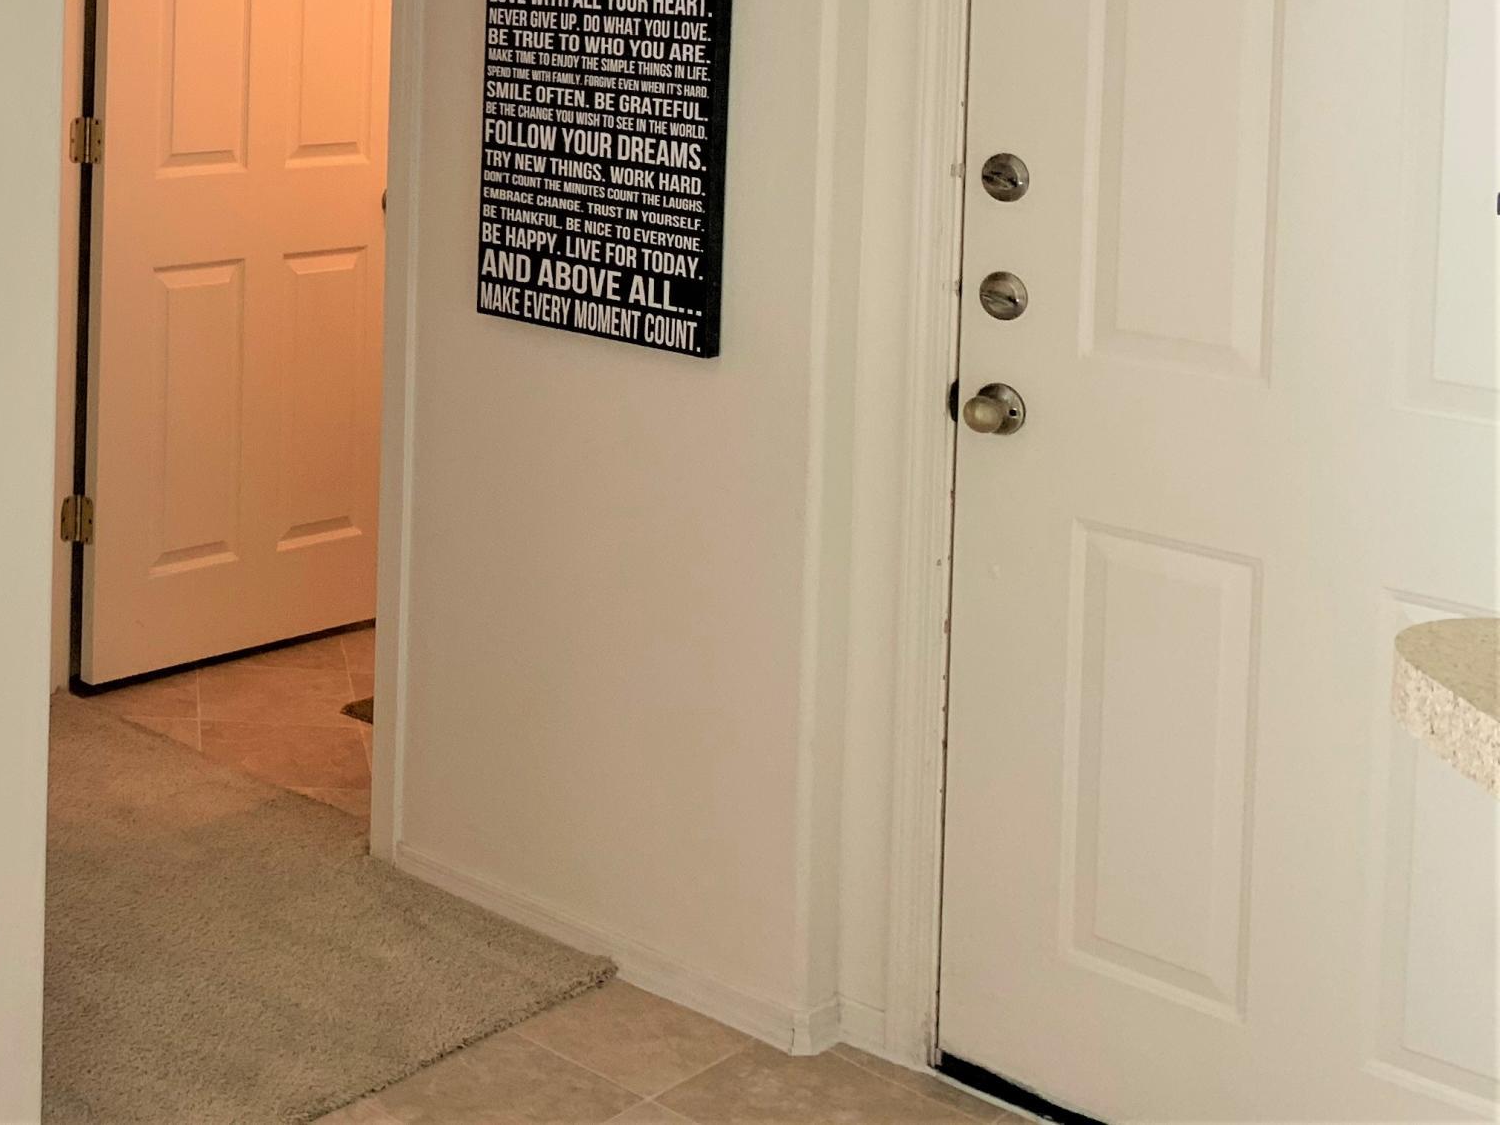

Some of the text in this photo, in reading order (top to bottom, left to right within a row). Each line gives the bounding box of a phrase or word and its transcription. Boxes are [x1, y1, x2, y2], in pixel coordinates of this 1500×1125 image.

[488, 7, 711, 41] NEVER GIVE UP. DO WHAT YOU LOVE.
[488, 27, 710, 63] BE TRUE TO WHO YOU ARE.
[487, 65, 709, 98] SPEND TIME WITH FAMILY. FORGIVE EVEN WHEN IT'S HARD.
[488, 47, 710, 81] MAKE TIME TO ENJOY THE SIMPLE THINGS IN LIFE.
[485, 101, 707, 139] BE THE CHANGE YOU WISH TO SEE IN THE WORLD.
[486, 80, 708, 121] SMILE OFTEN. BE GRATEFUL.
[485, 118, 706, 171] FOLLOW YOUR DREAMS.
[483, 169, 705, 213] DON'T COUNT THE MINUTES COUNT THE LAUGHS.
[484, 148, 705, 196] TRY NEW THINGS. WORK HARD.
[482, 203, 703, 252] BE THANKFUL. BE NICE TO EVERYONE.
[483, 186, 704, 231] EMBRACE CHANGE. TRUST IN YOURSELF.
[482, 221, 703, 280] BE HAPPY. LIVE FOR TODAY.
[481, 248, 702, 316] AND ABOVE ALL...
[480, 281, 700, 352] MAKE EVERY MOMENT COUNT.
